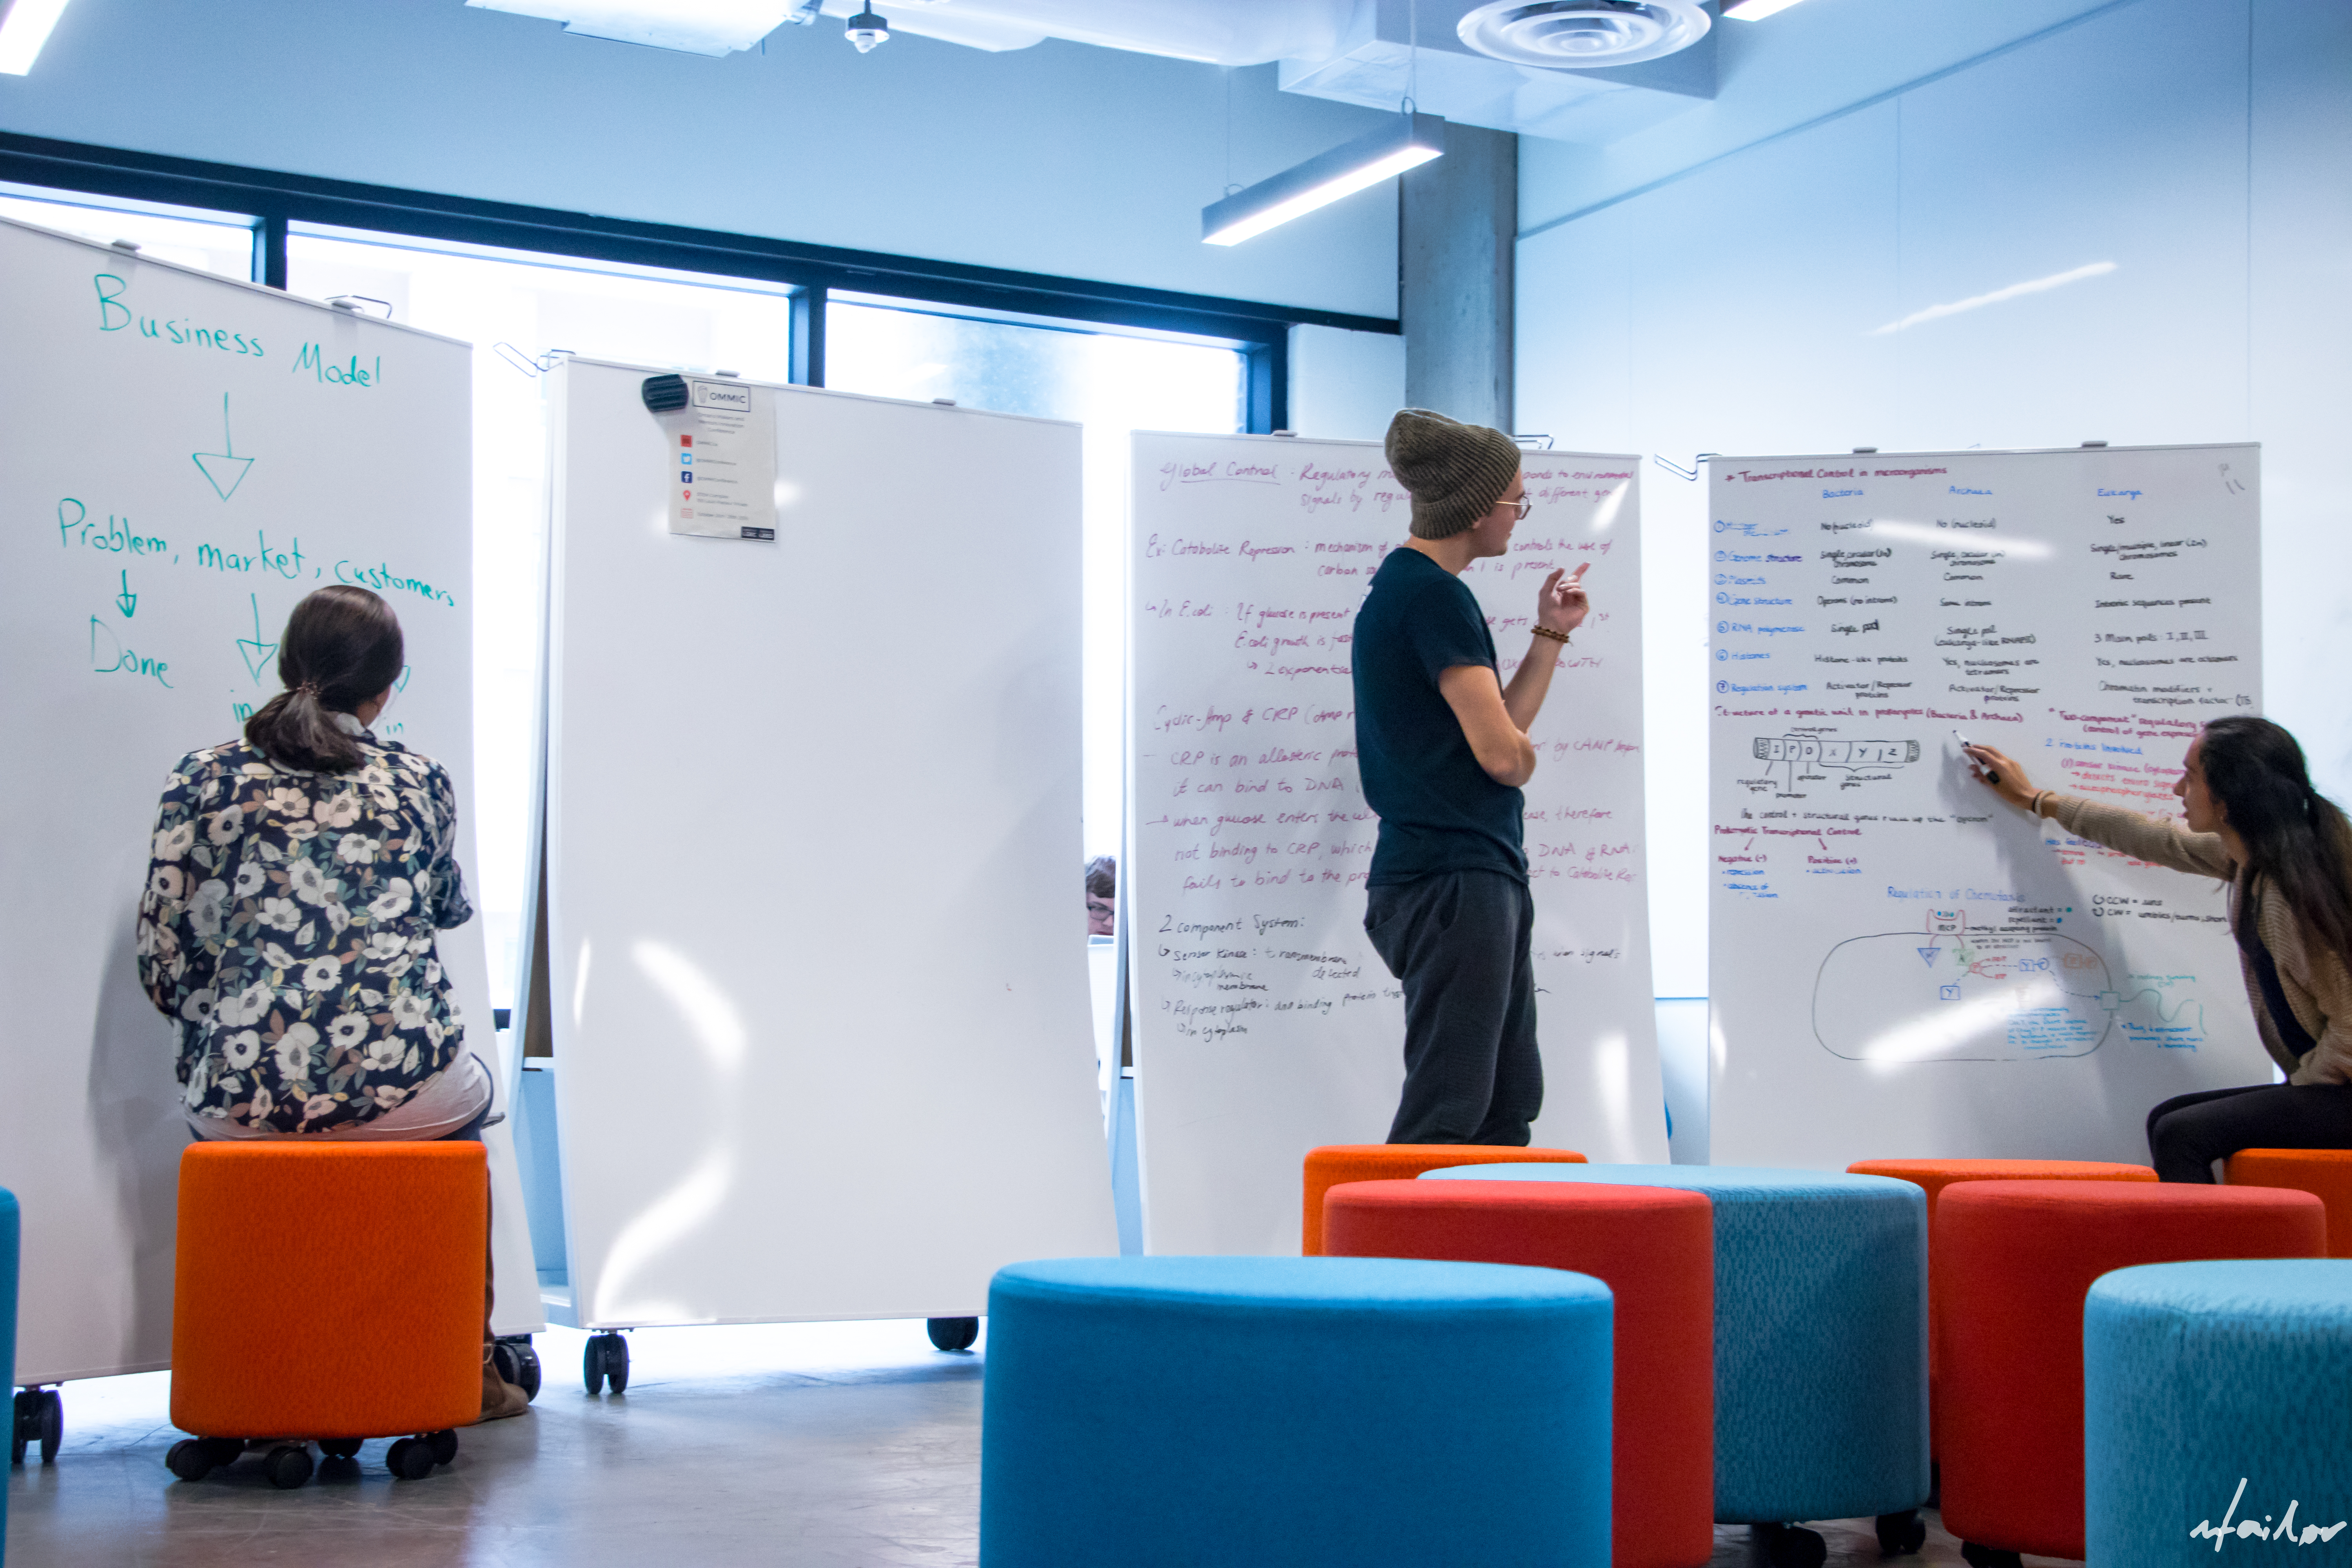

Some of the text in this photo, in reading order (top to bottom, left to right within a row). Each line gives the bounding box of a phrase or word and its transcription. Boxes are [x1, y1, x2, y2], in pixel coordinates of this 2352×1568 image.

[94, 274, 381, 387] Business Model
[710, 392, 746, 403] OMMIC
[1822, 488, 1864, 499] Bacteria
[2107, 515, 2125, 525] Yes
[91, 614, 174, 688] Done
[1261, 706, 1299, 721] CRP
[1170, 751, 1205, 766] CRP
[1197, 783, 1223, 793] can
[1235, 779, 1269, 793] bind
[1278, 780, 1294, 793] to
[1304, 777, 1344, 792] DNA
[1174, 843, 1200, 861] not
[1209, 842, 1258, 865] binding
[1266, 843, 1278, 854] to
[1537, 842, 1576, 857] DNA
[1254, 869, 1290, 886] bind
[1321, 870, 1341, 883] the
[1158, 914, 1172, 933] 2
